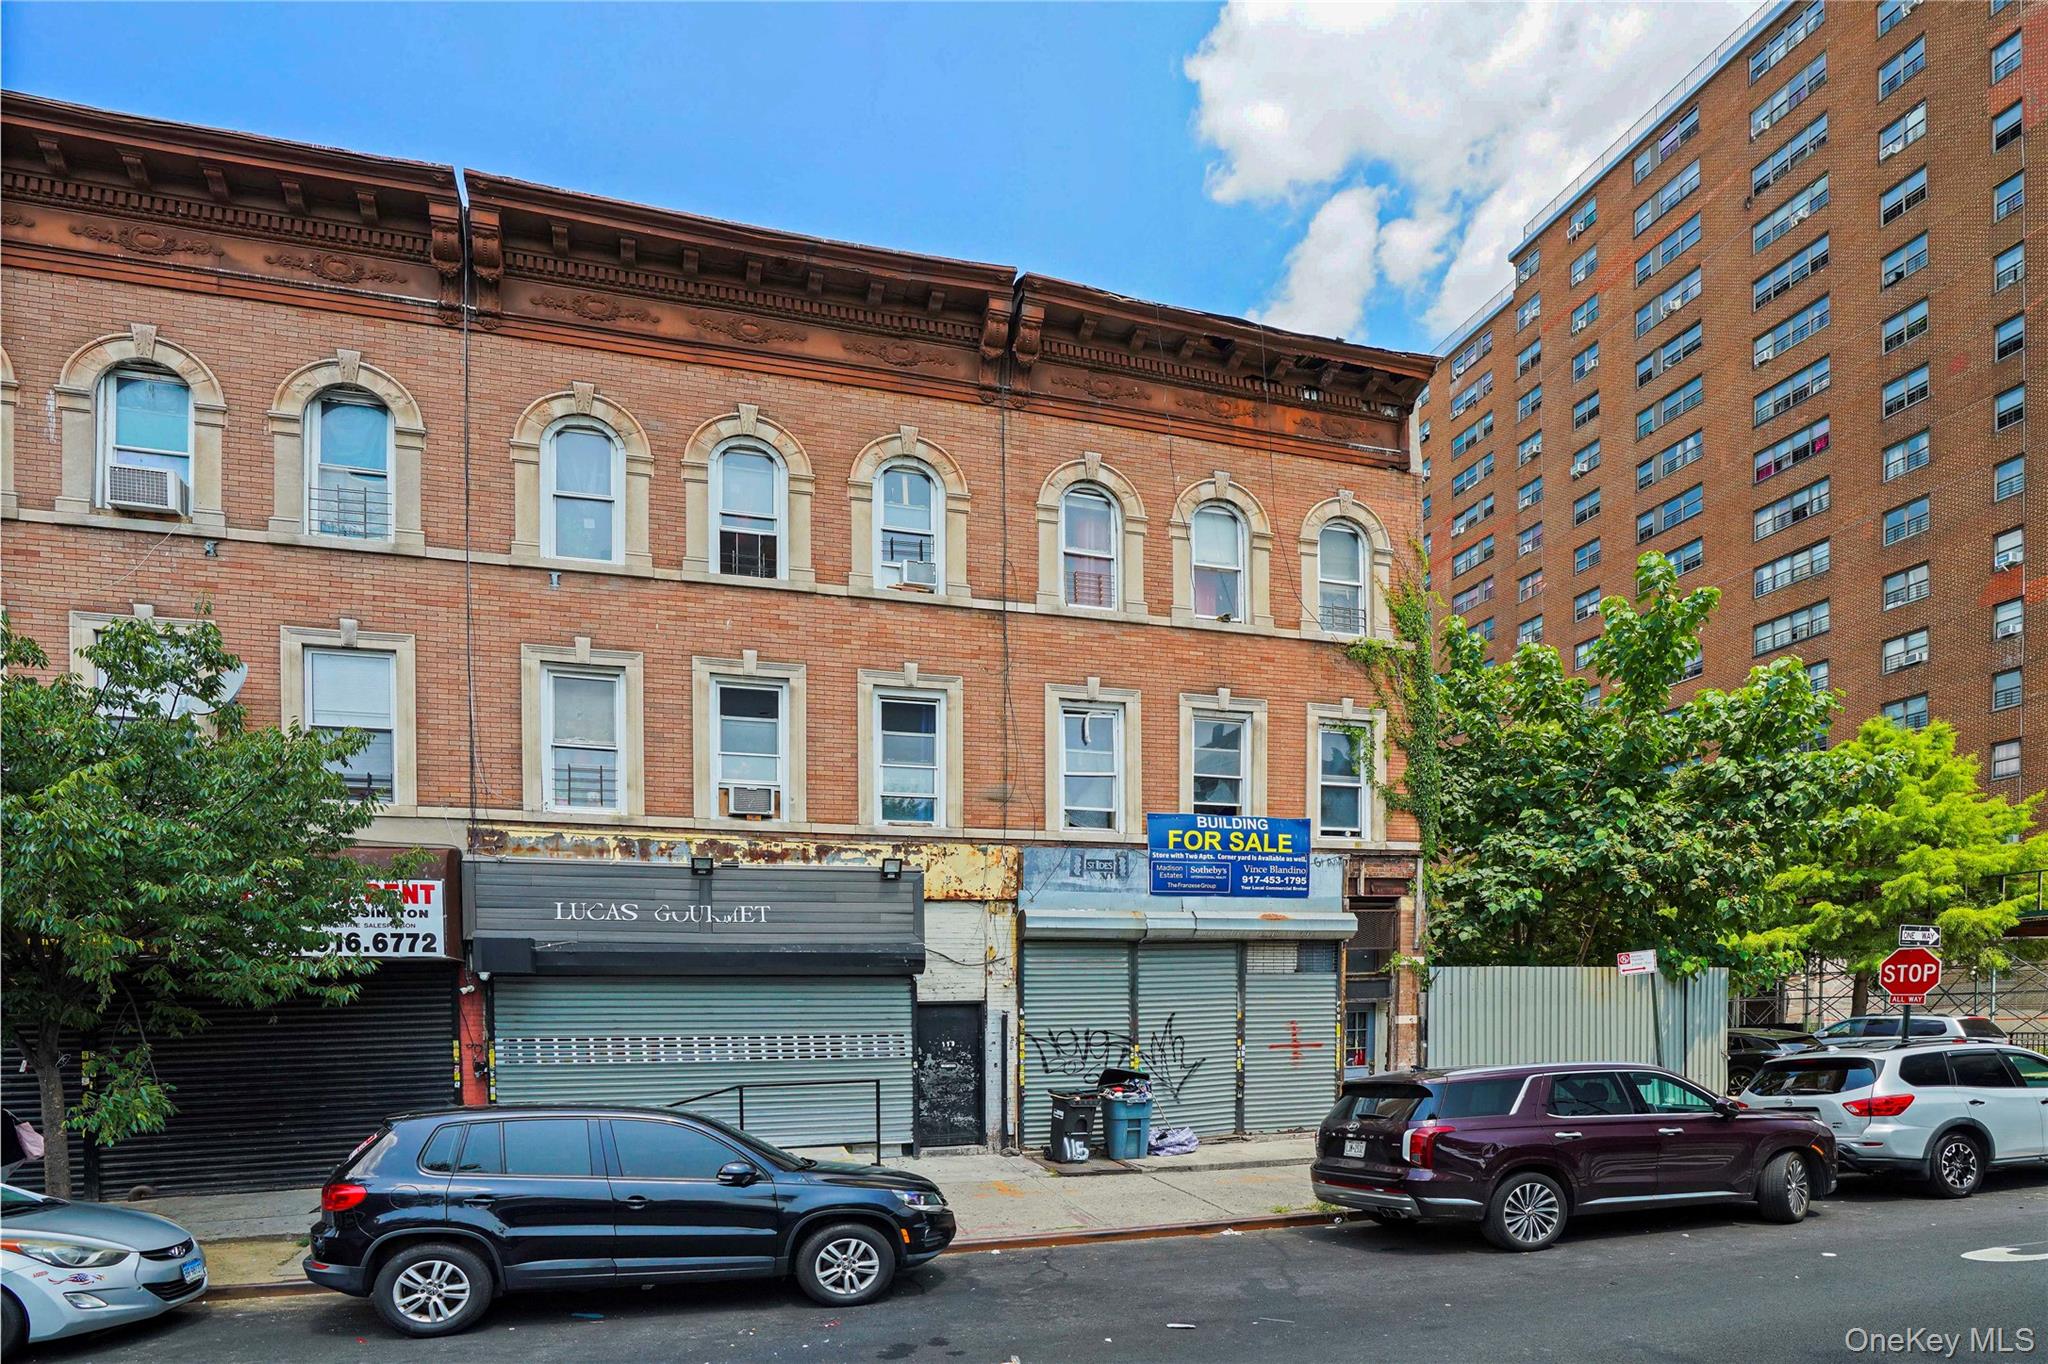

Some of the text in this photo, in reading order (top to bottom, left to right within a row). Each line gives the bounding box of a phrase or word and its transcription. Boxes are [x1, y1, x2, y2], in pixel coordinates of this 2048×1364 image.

[1197, 816, 1269, 830] BUILDING
[1168, 830, 1293, 853] FOR SALE
[1199, 853, 1215, 861] Apts.
[1190, 865, 1227, 875] Sotheby's
[1243, 865, 1307, 874] Vince Blandino
[1241, 876, 1307, 885] 917-453-1795
[554, 902, 639, 921] LUCAS
[1904, 932, 1935, 940] ONE WAY
[1884, 964, 1937, 983] STOP
